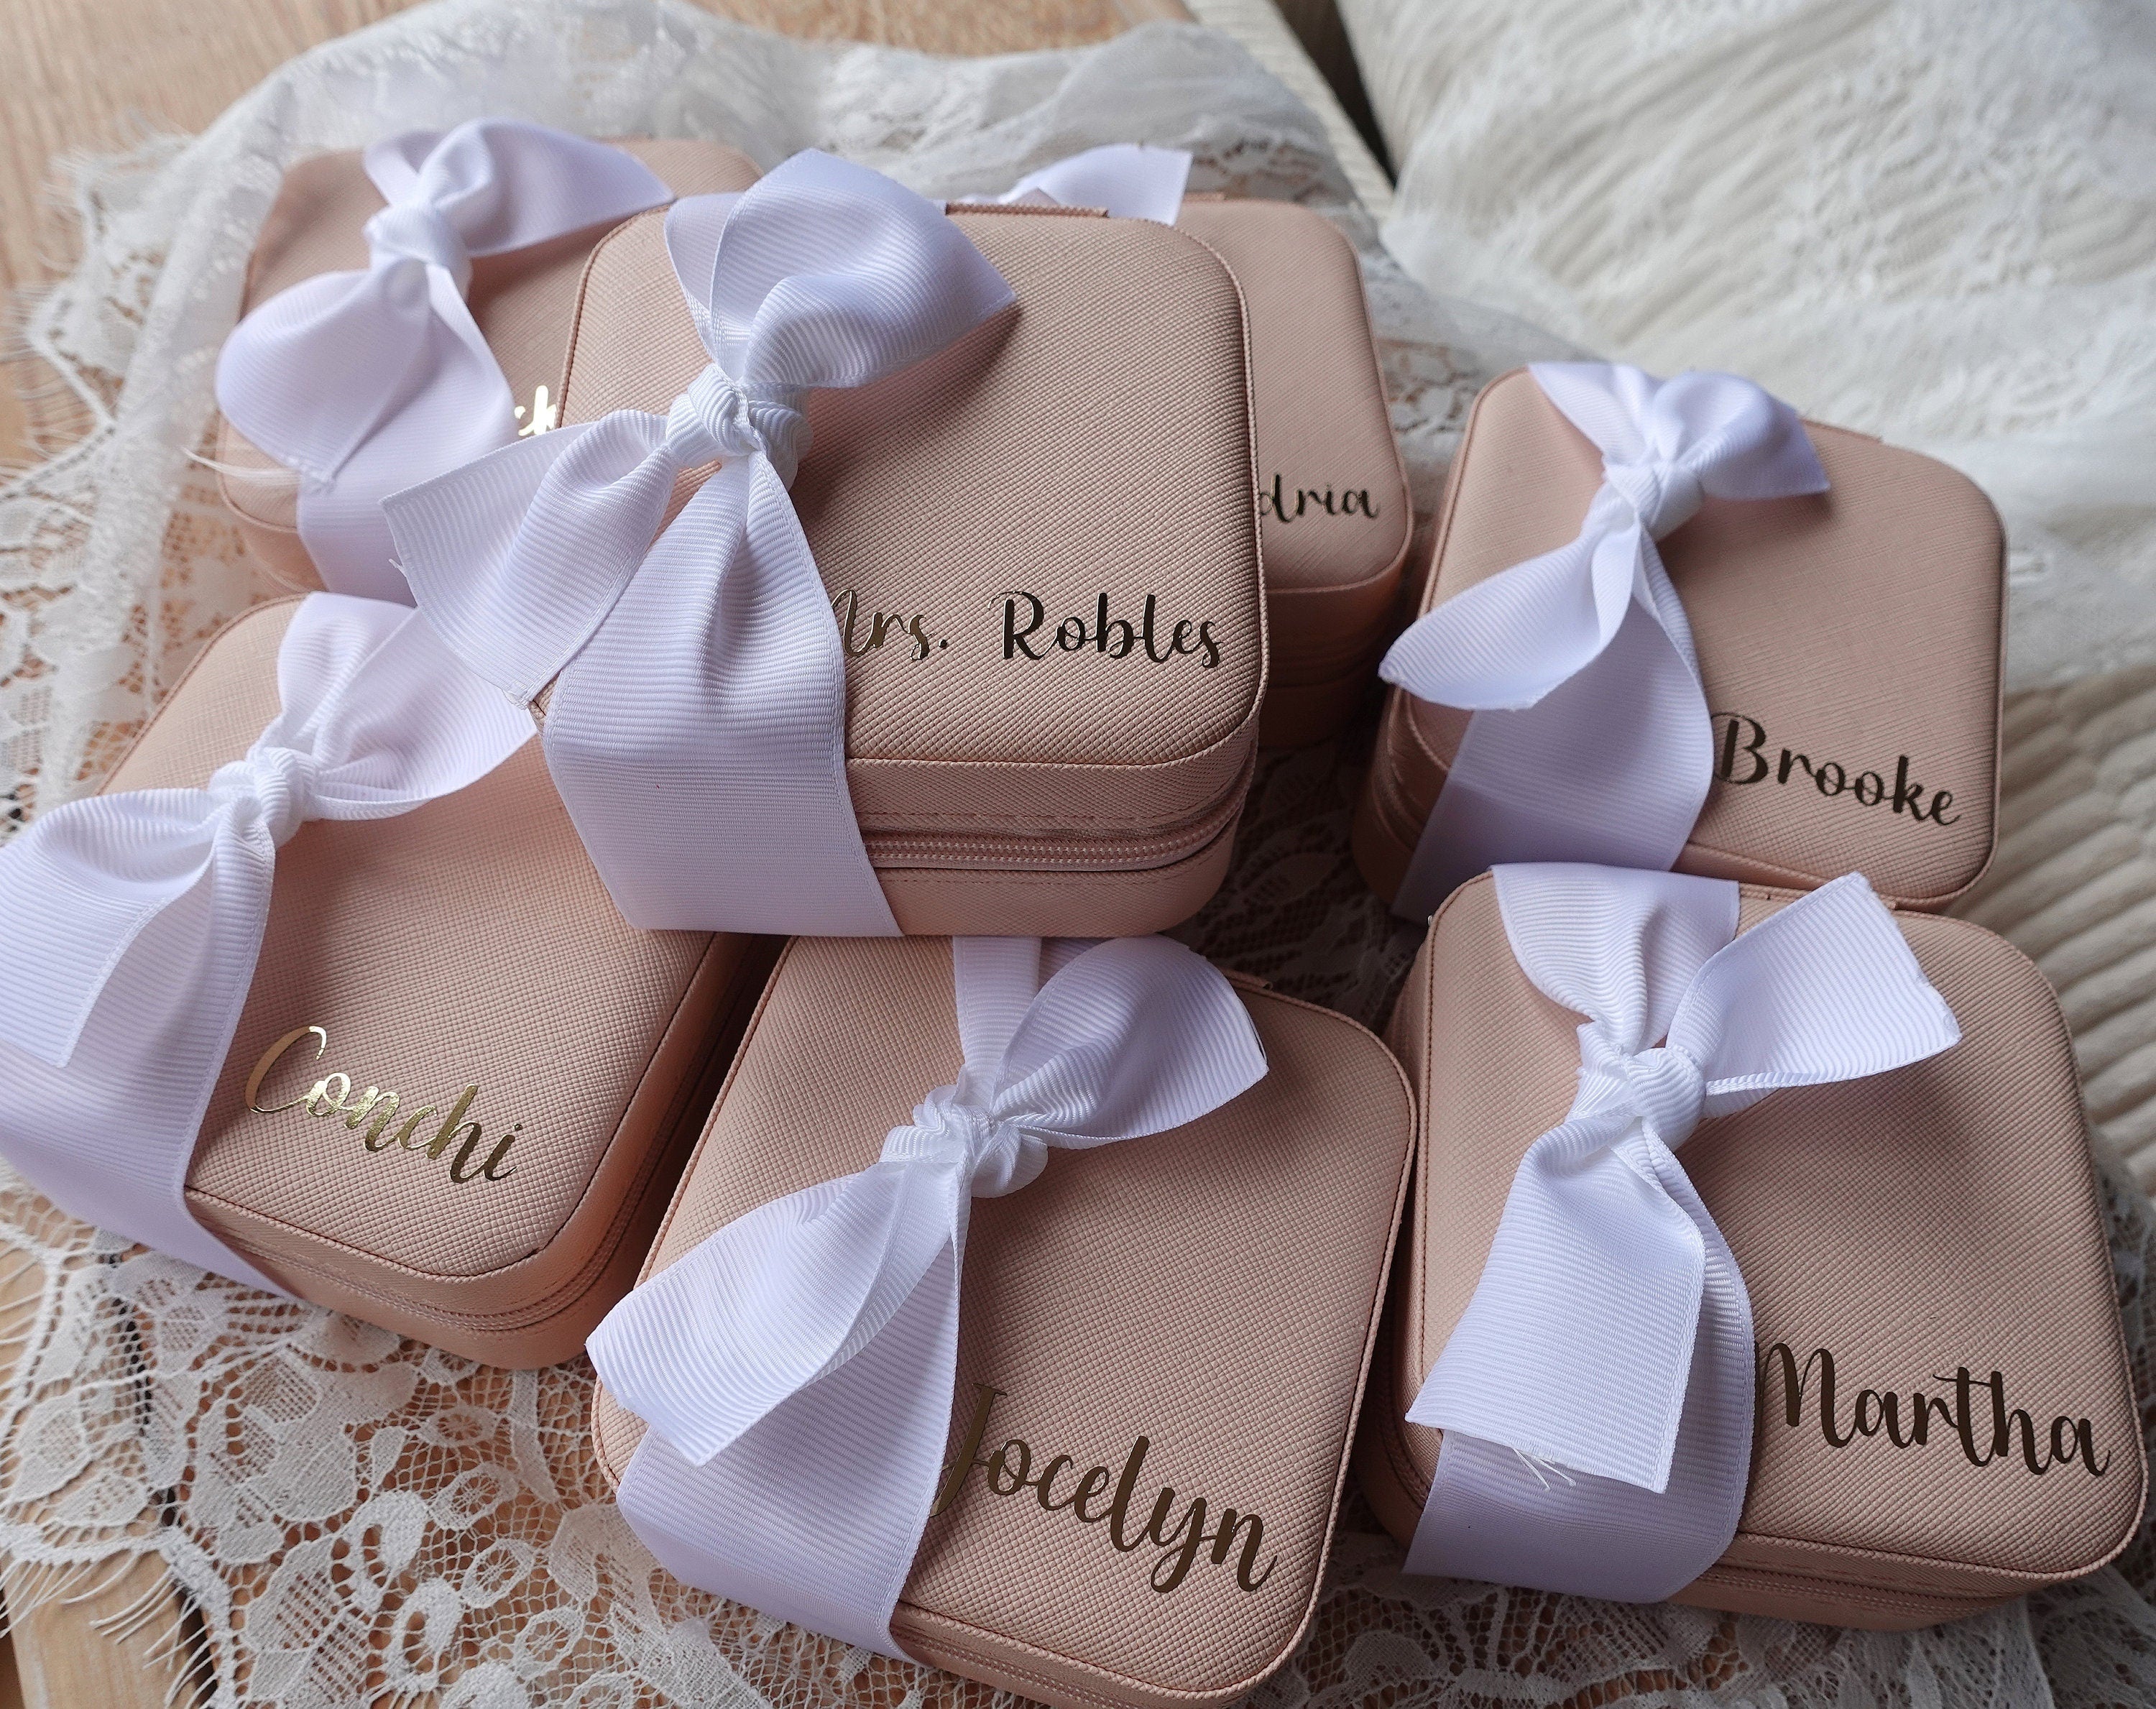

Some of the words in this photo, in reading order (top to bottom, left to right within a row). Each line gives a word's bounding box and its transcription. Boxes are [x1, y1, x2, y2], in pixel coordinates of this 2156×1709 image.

[988, 591, 1222, 668] Robles
[1710, 712, 1961, 825] Brooke
[245, 1026, 523, 1184] Conchi
[1755, 1342, 2111, 1476] Martha
[929, 1383, 1278, 1593] Jocelyn
